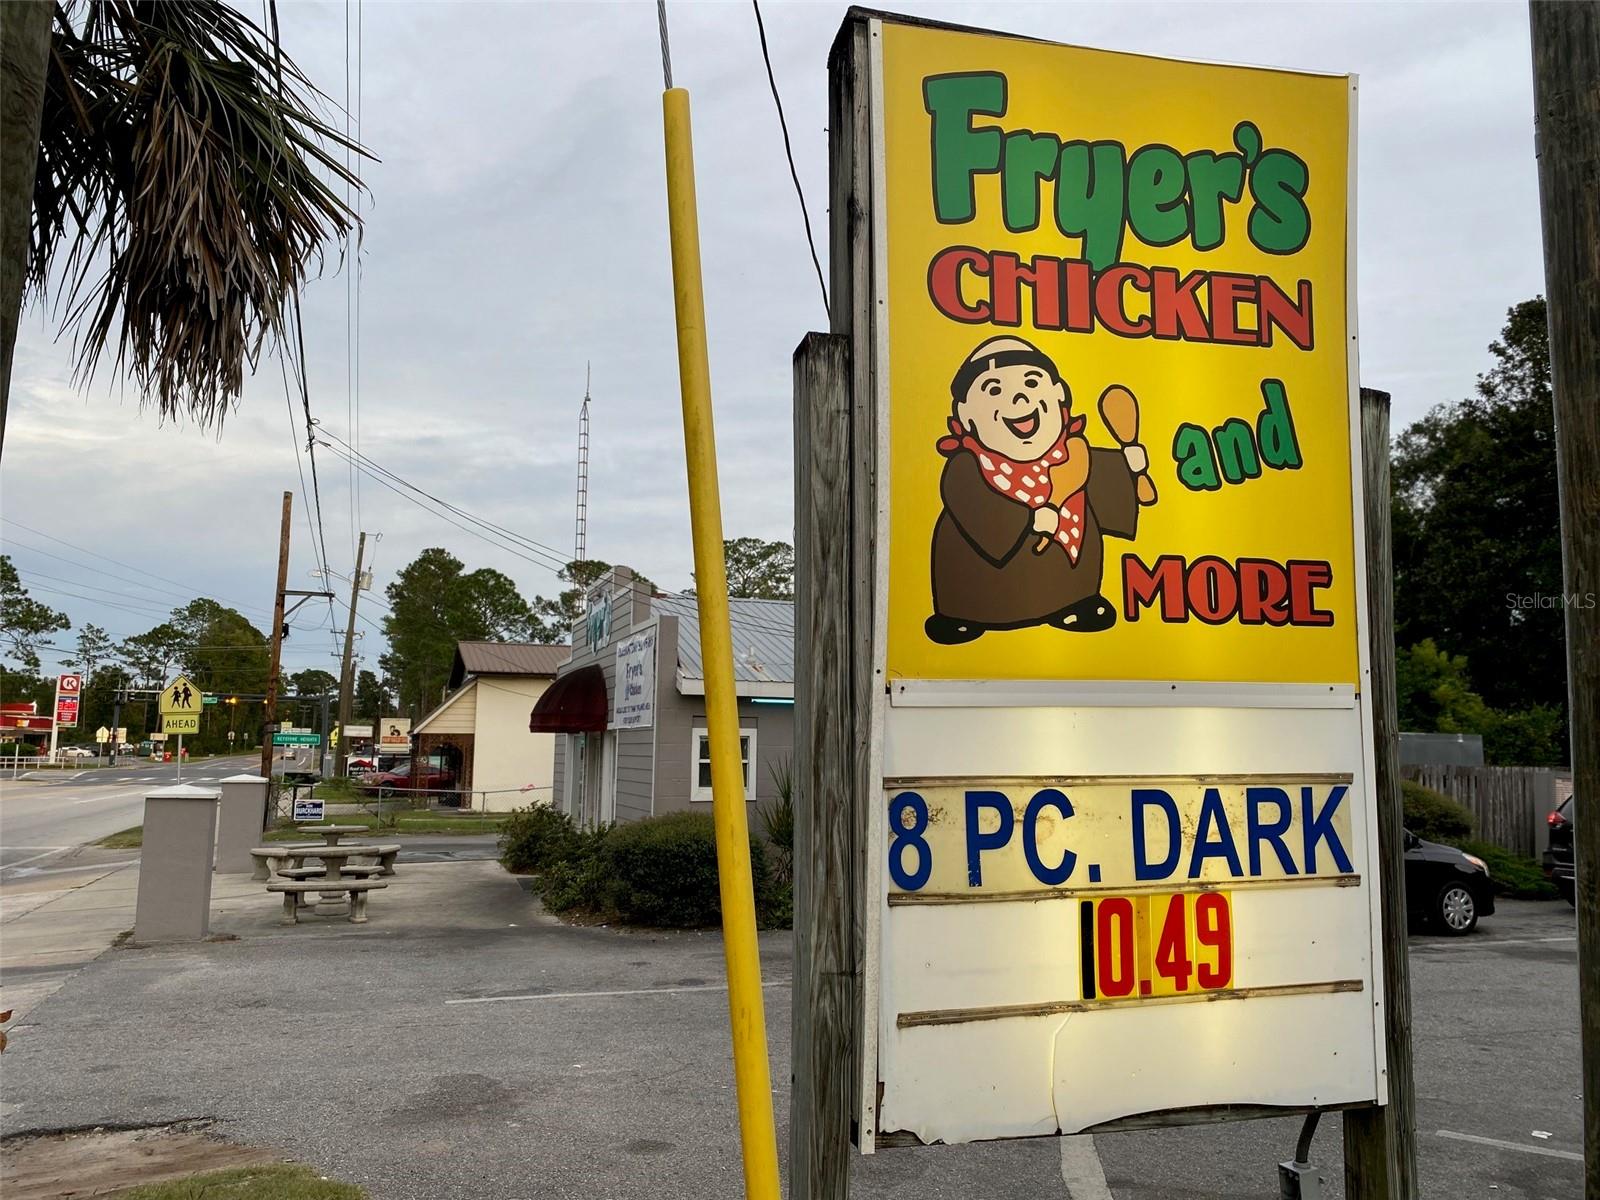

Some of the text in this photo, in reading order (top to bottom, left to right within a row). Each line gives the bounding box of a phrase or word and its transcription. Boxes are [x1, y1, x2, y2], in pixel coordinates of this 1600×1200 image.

[922, 71, 1311, 274] Fryer's
[927, 245, 1314, 351] CHICKEN
[1172, 378, 1303, 491] and
[1121, 554, 1334, 626] MORE
[165, 719, 197, 729] AHEAD
[888, 786, 1354, 891] 8 PC. DARK
